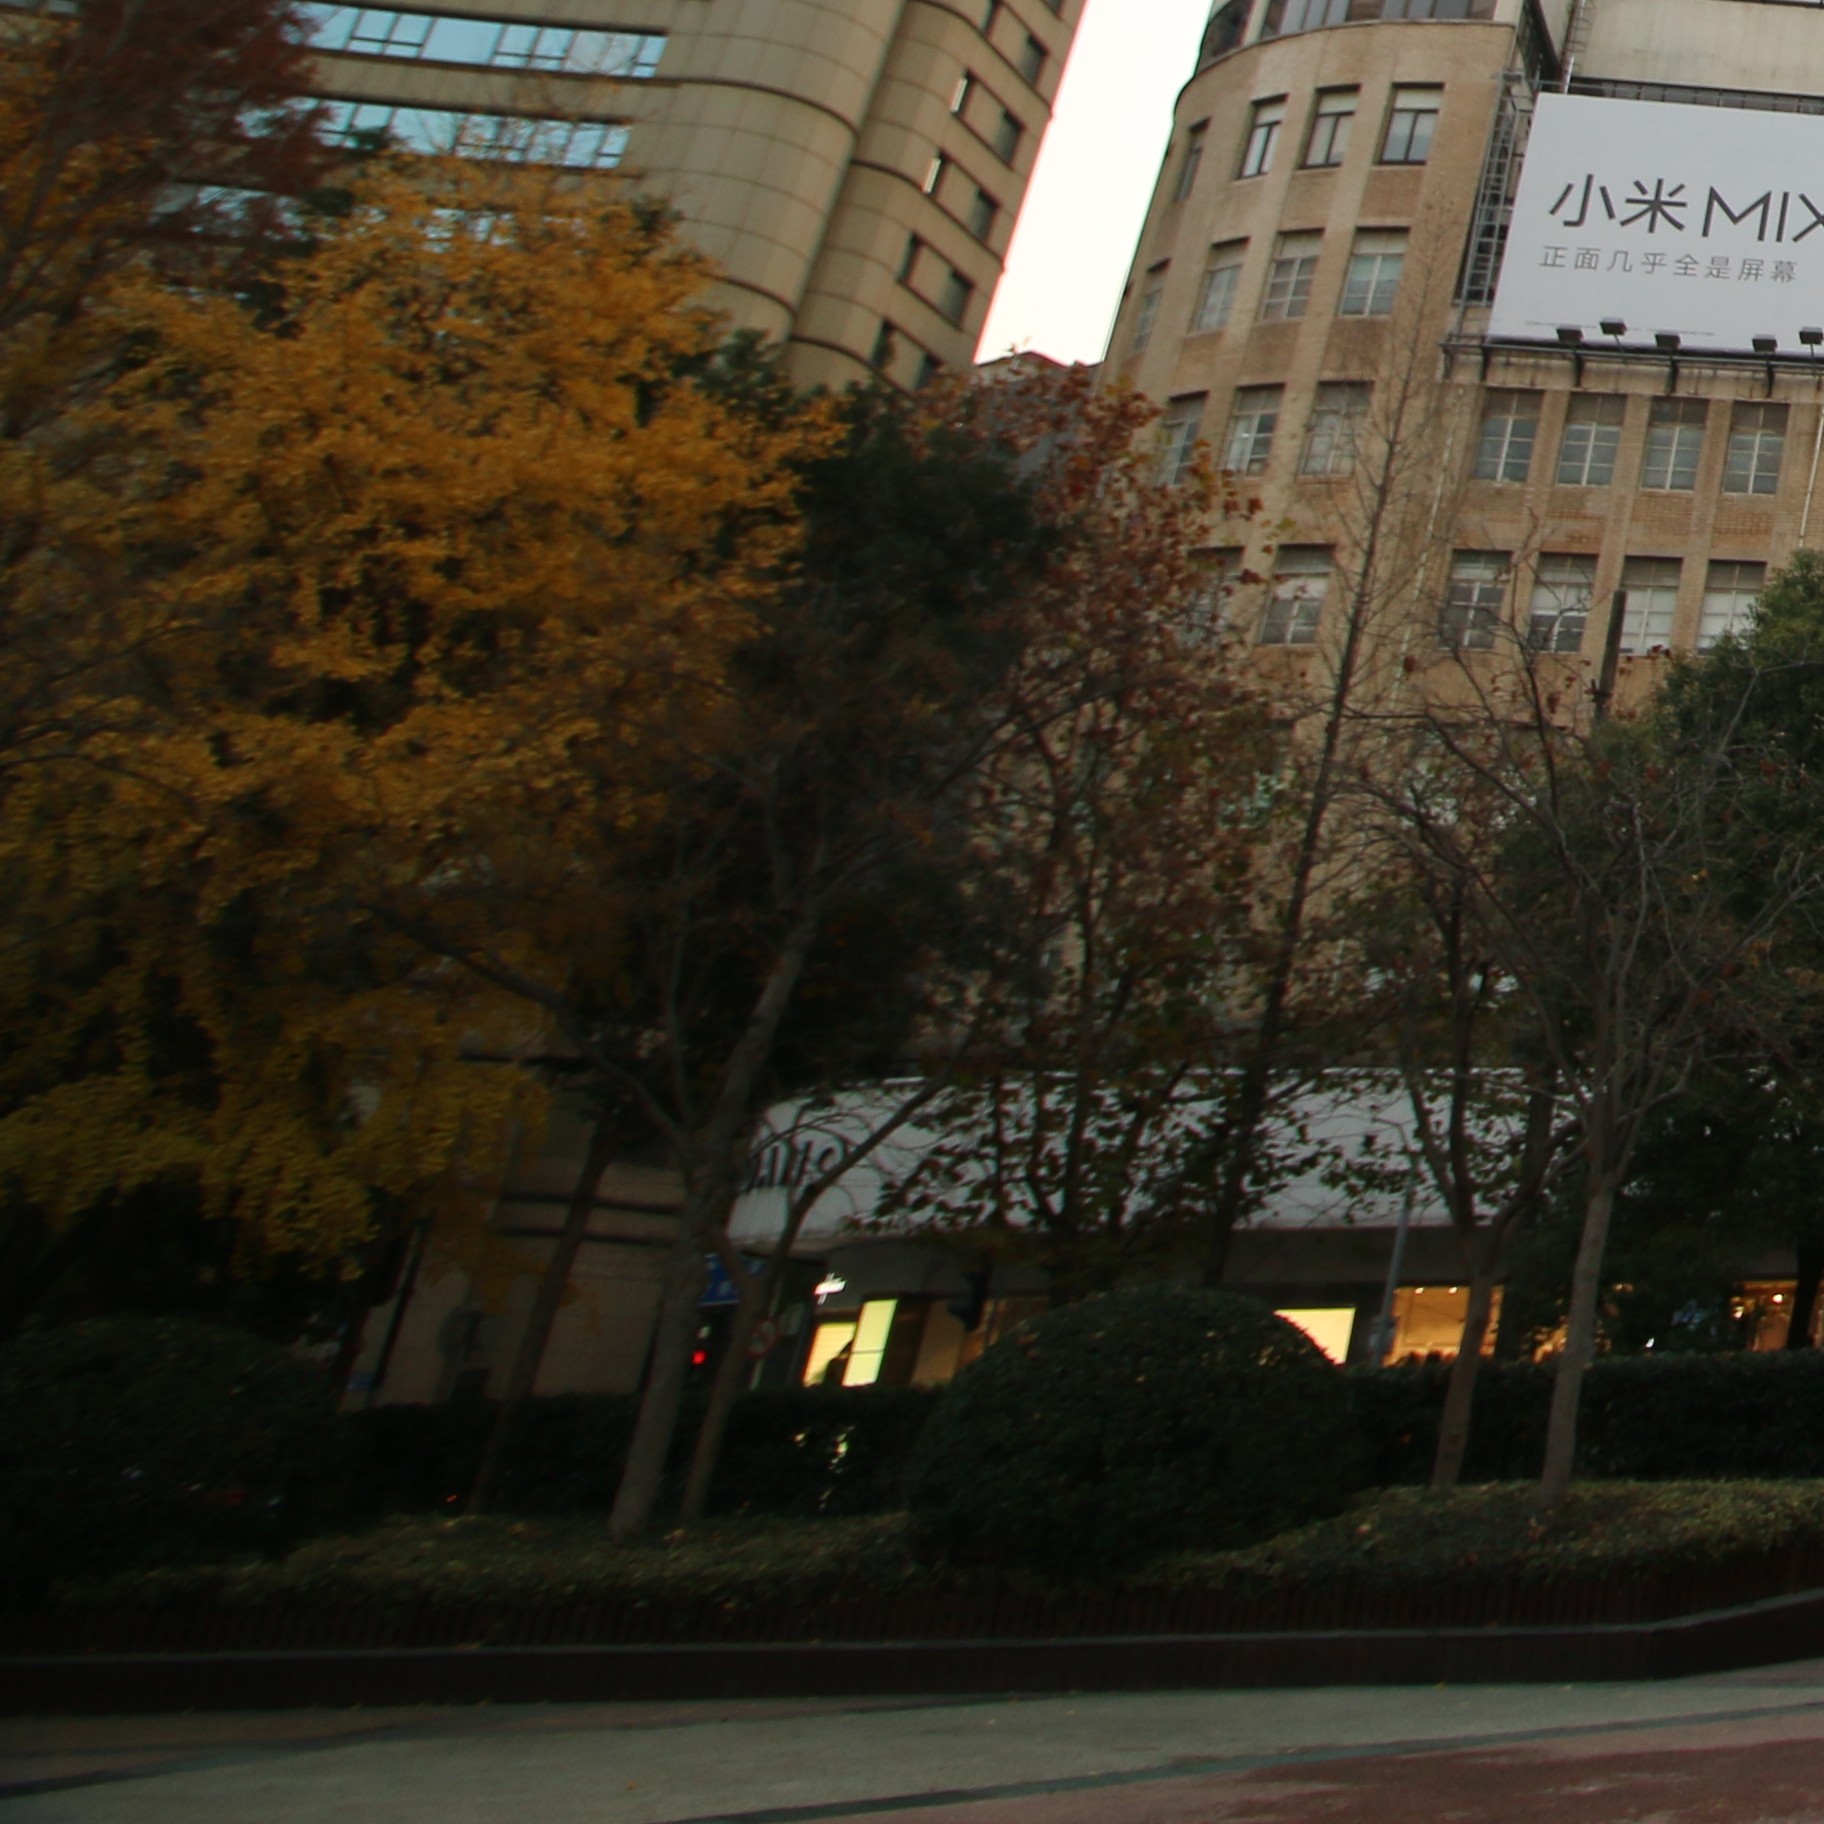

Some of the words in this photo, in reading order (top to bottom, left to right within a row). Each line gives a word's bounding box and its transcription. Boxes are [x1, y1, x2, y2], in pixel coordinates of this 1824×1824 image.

[1538, 245, 1798, 284] 正面几乎全是屏幕
